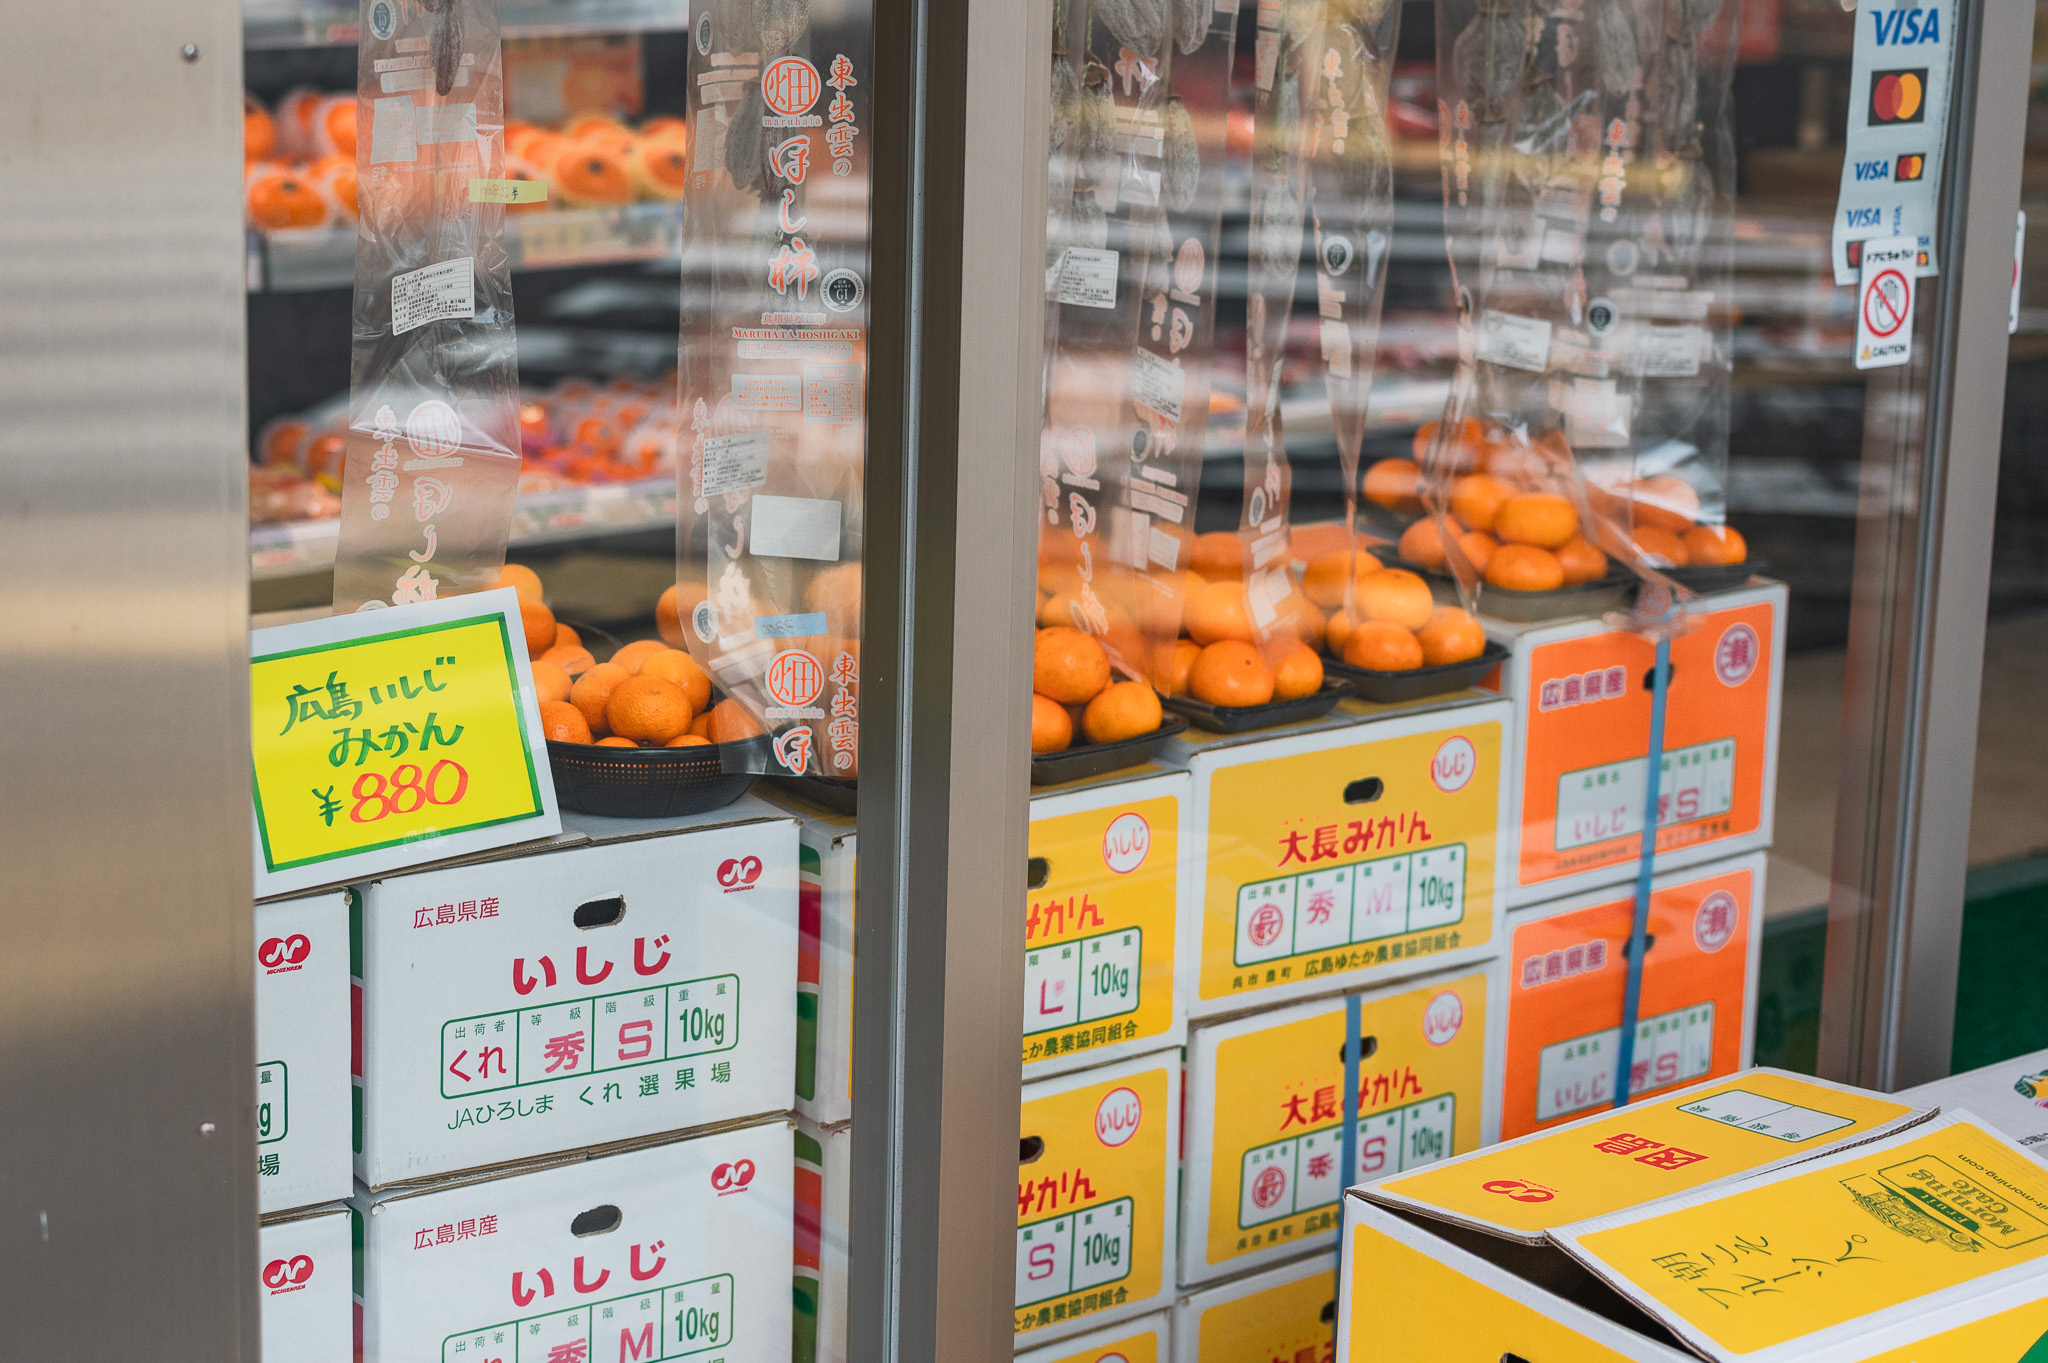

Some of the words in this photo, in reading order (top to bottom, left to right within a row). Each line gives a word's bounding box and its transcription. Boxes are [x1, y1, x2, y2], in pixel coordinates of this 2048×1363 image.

[1869, 8, 1941, 47] VISA
[765, 60, 819, 115] 畑
[764, 116, 822, 127] maruhata
[828, 56, 857, 175] 東出雲の
[1854, 160, 1890, 182] VISA
[769, 137, 818, 299] ほし柿
[1846, 207, 1882, 229] VISA
[836, 288, 849, 301] GI
[733, 329, 796, 339] MARUHATA
[798, 330, 860, 340] HOSHIGAKI
[763, 314, 826, 325] 島根県松江市
[767, 653, 824, 707] 畑
[1540, 666, 1627, 711] 広島県産
[767, 708, 824, 719] maruhata
[832, 655, 859, 768] 東出雲の
[328, 712, 465, 768] みかん
[1676, 787, 1700, 819] S
[1105, 826, 1146, 861] いしじ
[1277, 809, 1432, 869] 大長みかん
[724, 884, 755, 894] NICHIENREN
[1306, 888, 1336, 925] 秀
[1365, 883, 1393, 916] M
[1419, 875, 1455, 910] 10kg
[413, 896, 500, 930] 広島県産
[266, 964, 303, 975] NICHIENREN
[512, 933, 672, 996] いしじ
[1303, 930, 1462, 979] 広島ゆたか農業協同組合
[678, 983, 727, 1002] 重量
[1039, 978, 1064, 1015] L
[1091, 962, 1129, 999] 10kg
[530, 1006, 582, 1027] 等級
[605, 994, 656, 1015] 階級
[454, 1019, 506, 1040] 出荷者
[617, 1019, 653, 1062] S
[679, 1006, 725, 1044] 10kg
[449, 1045, 507, 1083] くれ
[543, 1031, 586, 1074] 秀
[257, 1102, 272, 1130] g
[447, 1094, 555, 1131] JAひろしま
[1099, 1102, 1138, 1135] いしじ
[1362, 1136, 1387, 1174] S
[1411, 1126, 1444, 1160] 10kg
[1593, 1133, 1710, 1171] 因島
[1906, 1168, 2020, 1237] Morning
[1920, 1193, 1968, 1225] Fruit
[1951, 1179, 2009, 1215] Cafe
[413, 1214, 499, 1251] 広島県産
[1083, 1232, 1121, 1268] 10kg
[511, 1239, 667, 1308] いしじ
[1027, 1242, 1055, 1281] S
[1651, 1235, 1773, 1283] 朝こそ
[270, 1284, 307, 1296] NICHIENREN
[674, 1282, 721, 1303] 重量
[529, 1314, 579, 1335] 等級
[602, 1298, 651, 1320] 階級
[675, 1307, 720, 1343] 10kg
[454, 1331, 505, 1353] 出荷者
[619, 1322, 654, 1363] M
